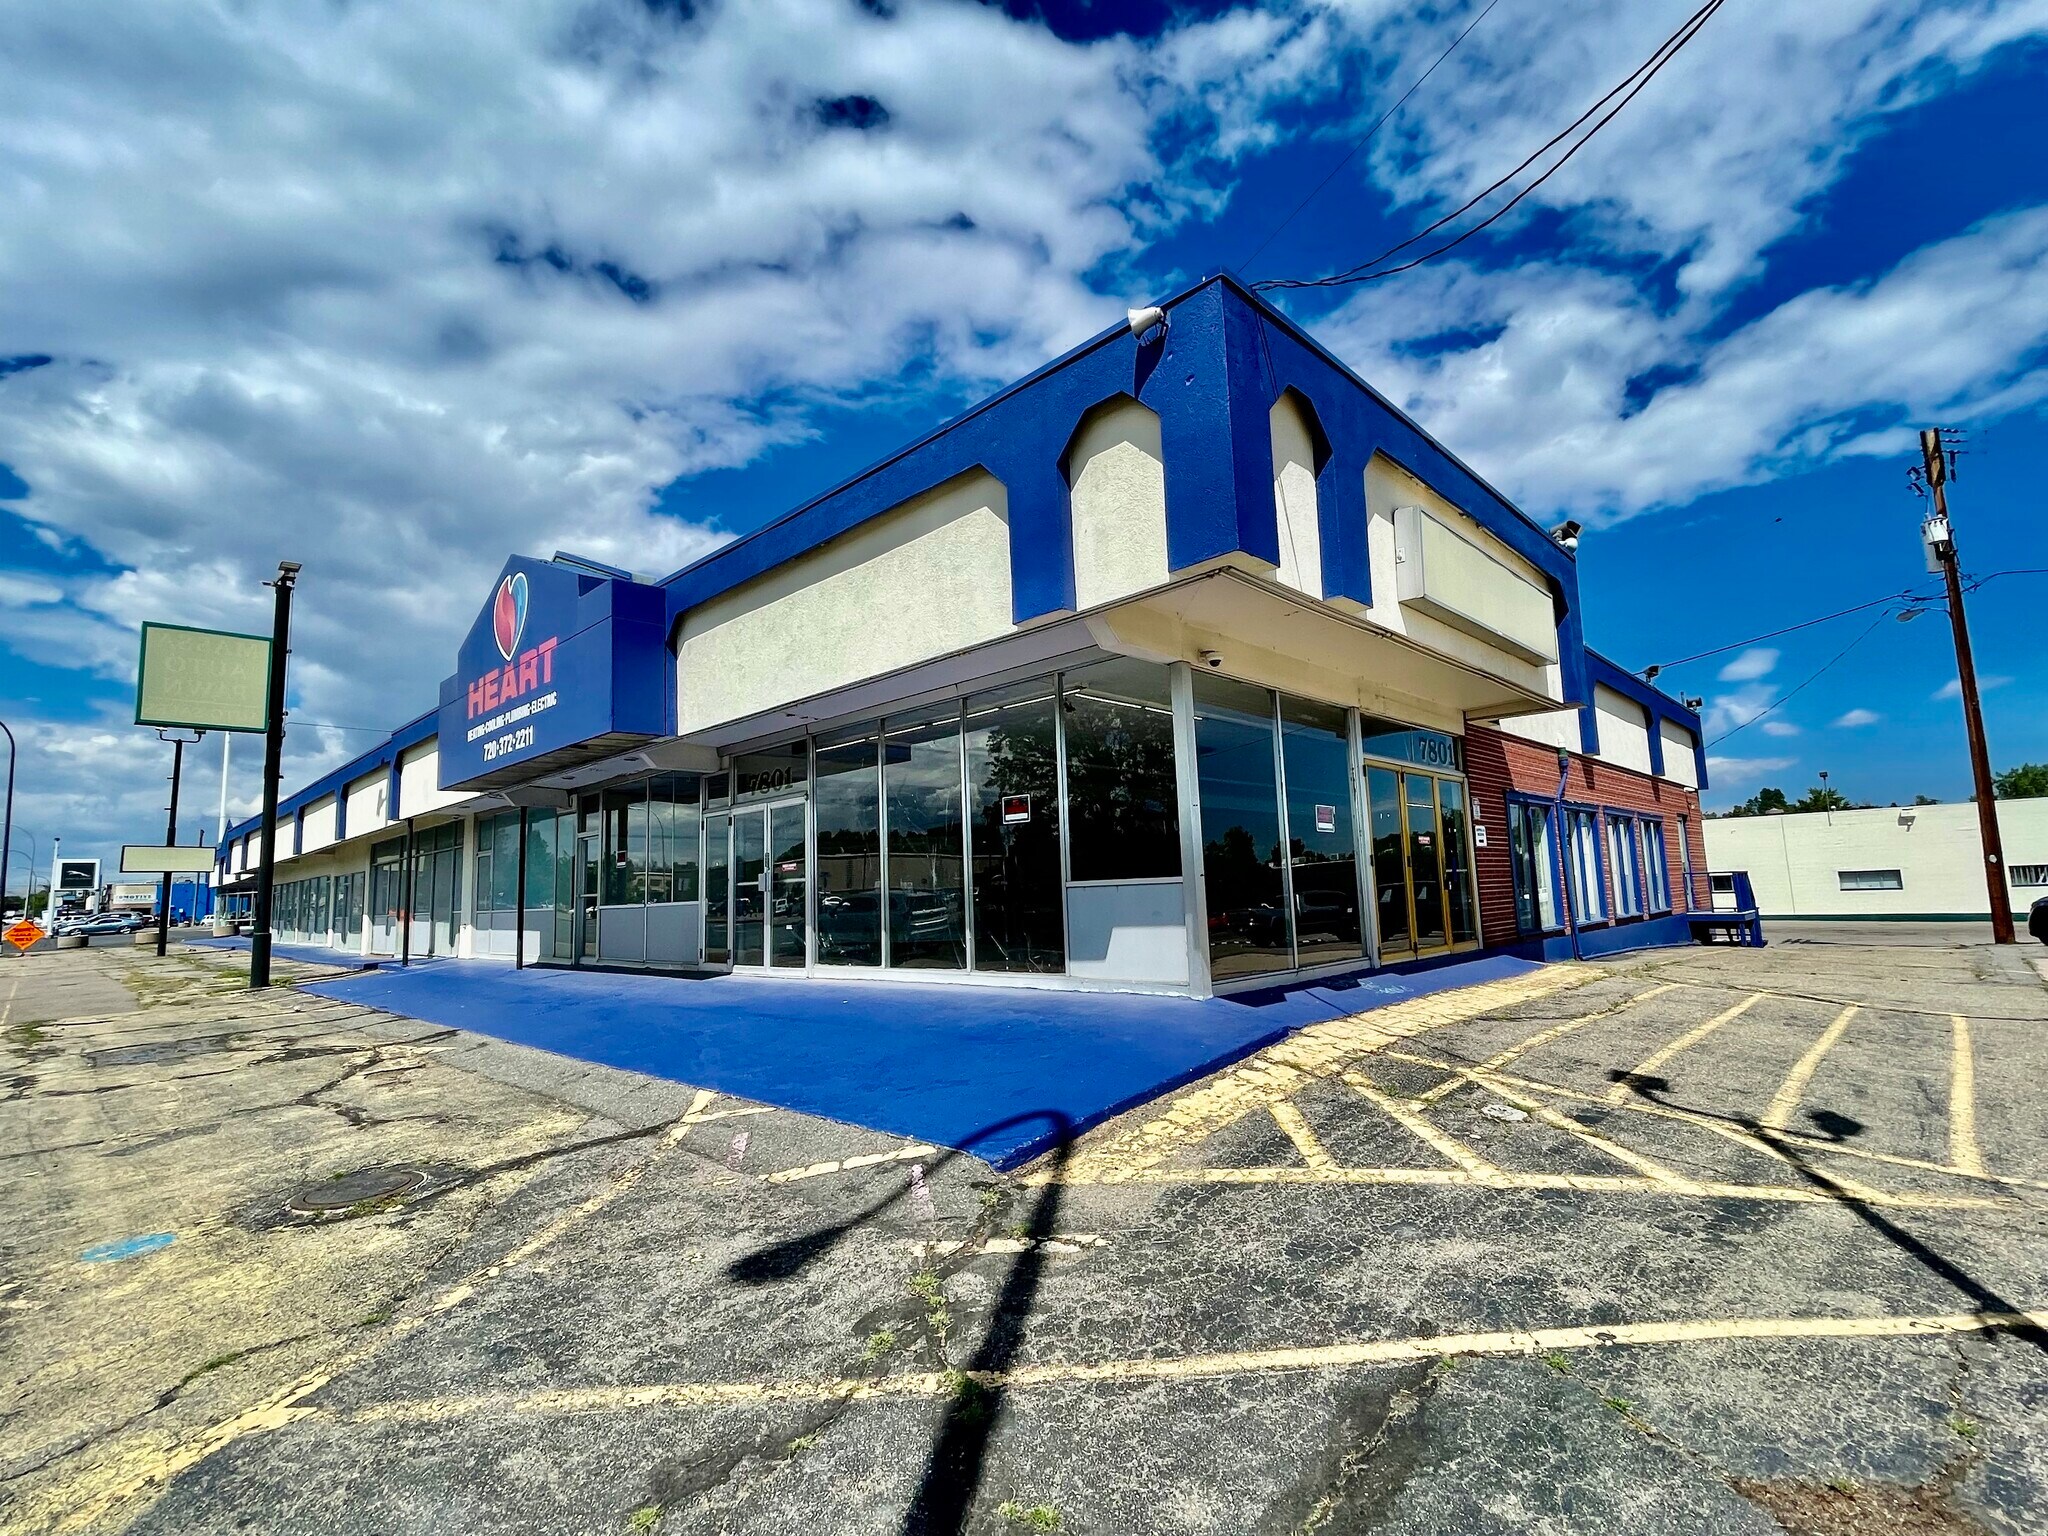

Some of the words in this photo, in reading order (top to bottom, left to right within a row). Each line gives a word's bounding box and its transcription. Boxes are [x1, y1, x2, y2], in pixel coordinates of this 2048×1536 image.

[468, 636, 557, 720] HEART
[1419, 737, 1455, 766] 7801
[749, 766, 794, 796] 7801
